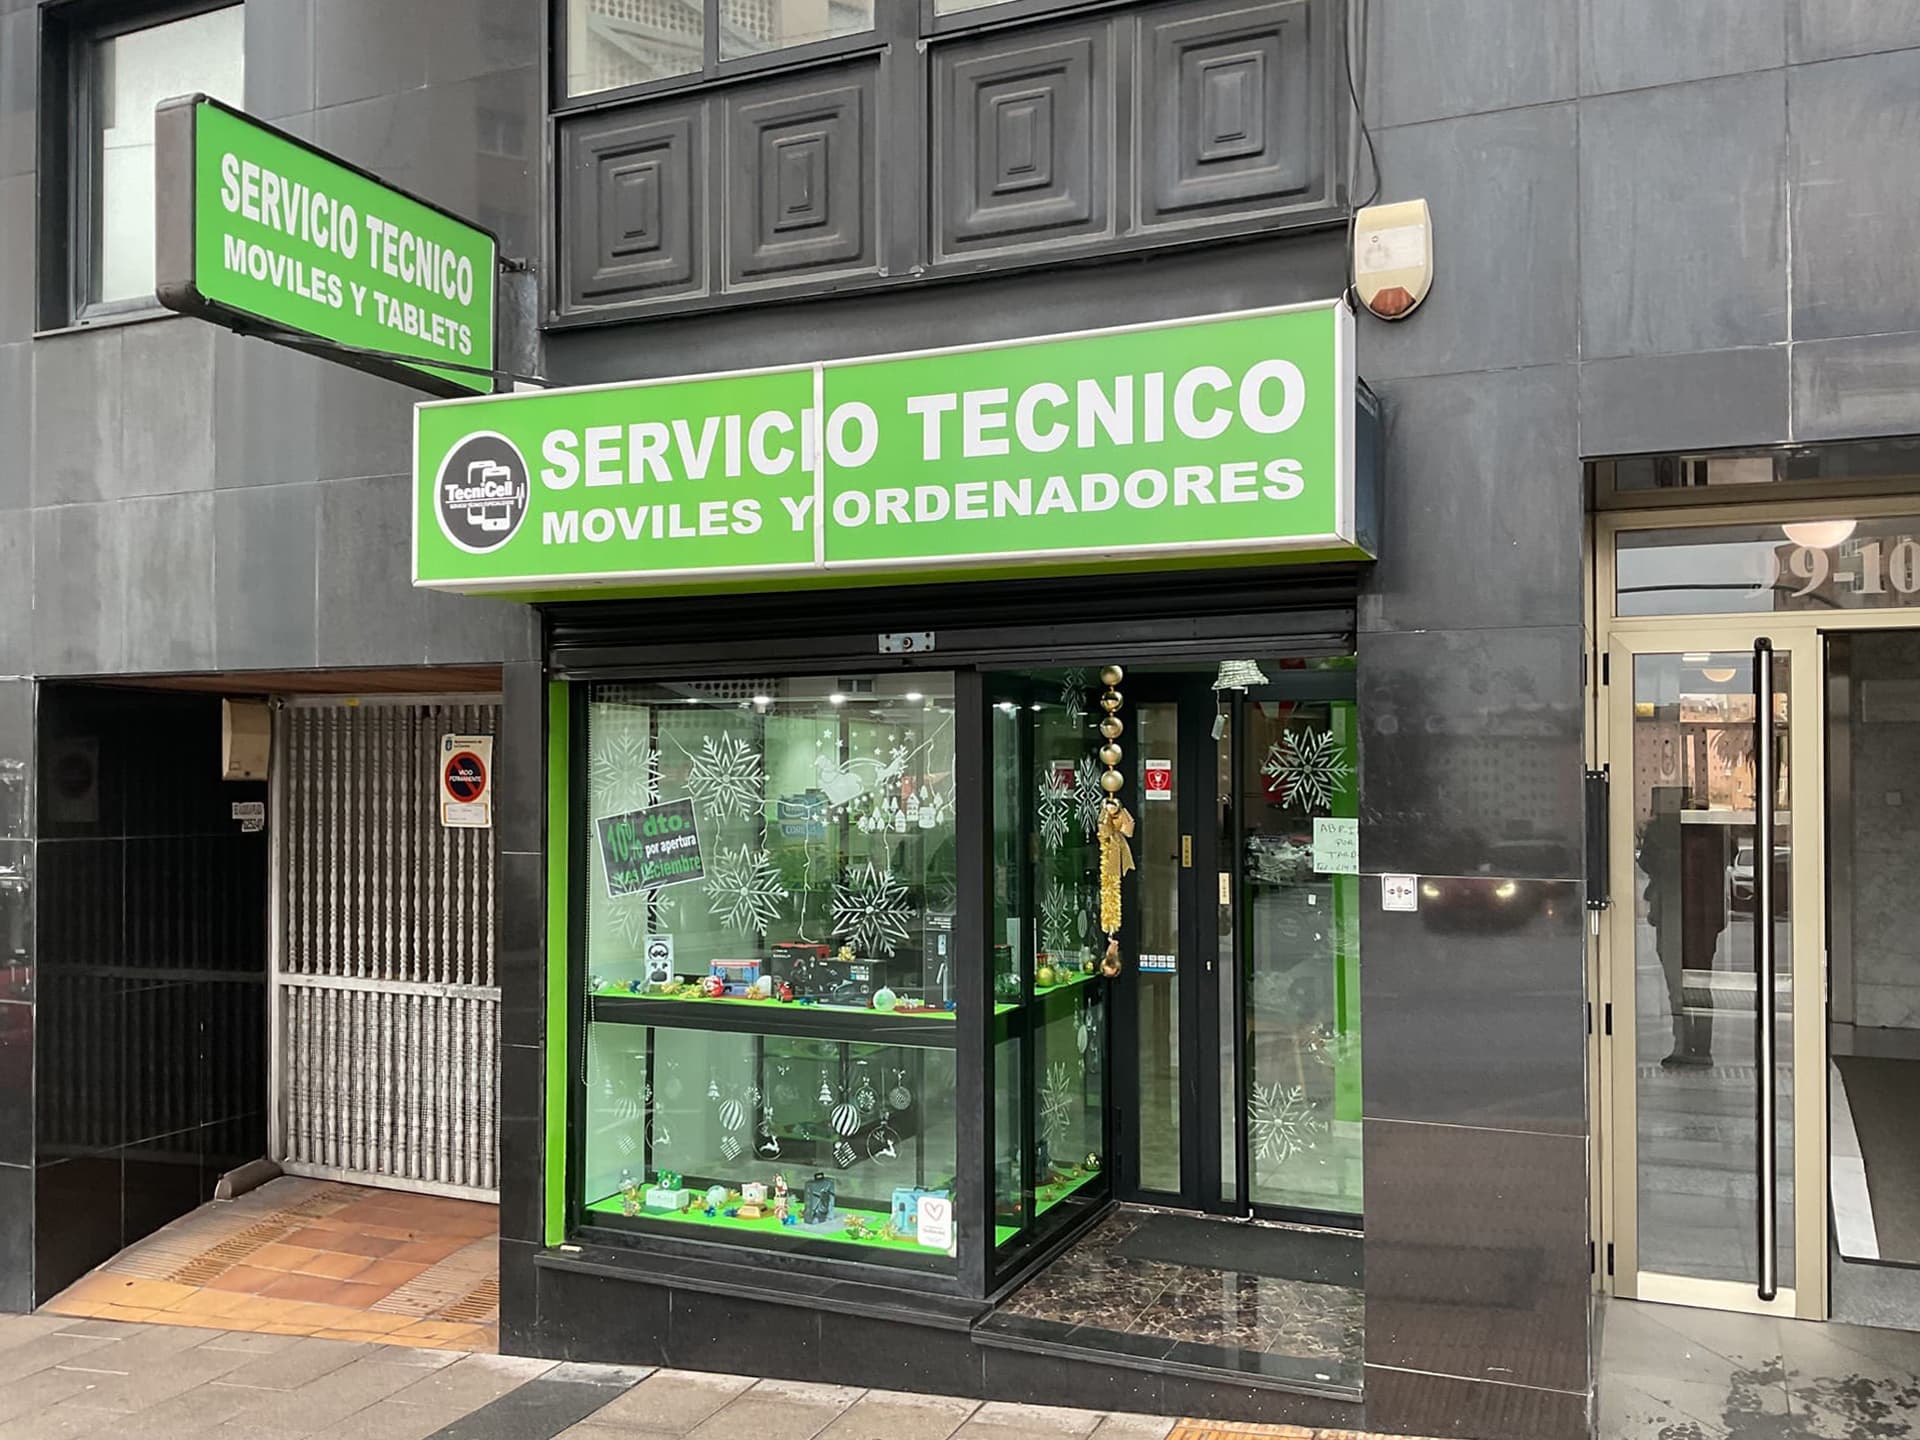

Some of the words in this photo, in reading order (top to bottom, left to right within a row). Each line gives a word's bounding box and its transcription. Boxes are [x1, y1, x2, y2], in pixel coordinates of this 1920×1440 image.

[221, 153, 358, 260] SERVICIO
[366, 214, 473, 306] TECNICO
[223, 233, 344, 308] MOVILES
[350, 281, 366, 317] Y
[373, 291, 472, 356] TABLETS
[540, 401, 879, 490] SERVICIO
[907, 359, 1306, 461] TECNICO
[444, 481, 513, 501] TecniCell
[542, 498, 763, 545] MOVILES
[780, 495, 815, 532] Y
[833, 458, 1305, 528] ORDENADORES
[607, 820, 644, 863] 10%
[644, 814, 690, 837] dto.
[645, 842, 660, 859] por
[660, 835, 696, 853] apertura
